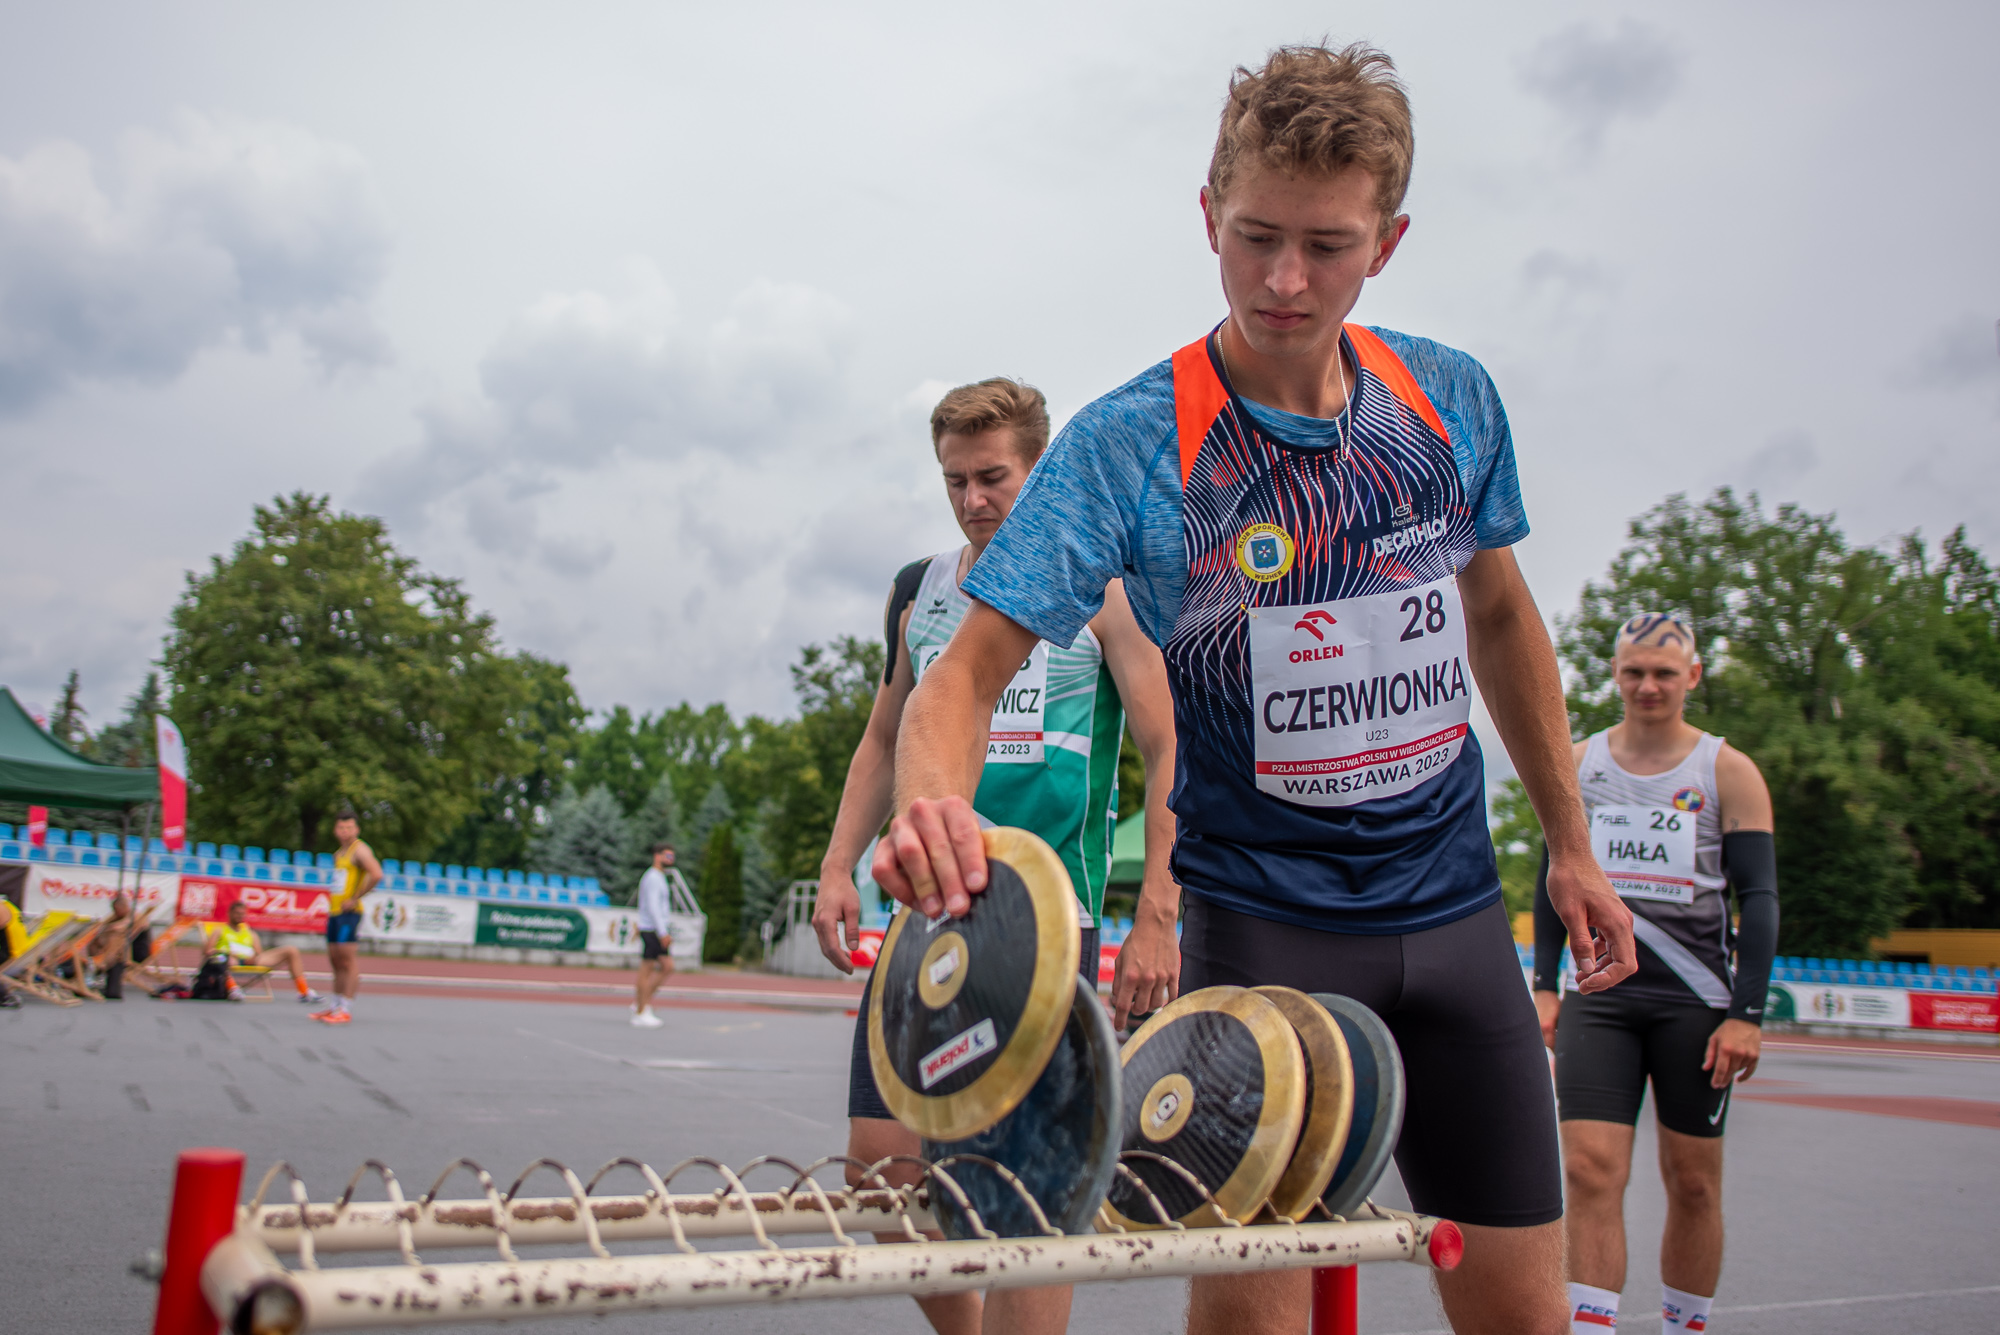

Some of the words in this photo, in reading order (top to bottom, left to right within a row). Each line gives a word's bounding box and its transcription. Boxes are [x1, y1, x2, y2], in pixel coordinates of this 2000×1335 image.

[1238, 531, 1251, 549] KLUB
[1253, 524, 1290, 541] SPORTOWY
[1254, 570, 1283, 580] WEJHER
[1399, 589, 1446, 642] 28
[1288, 644, 1344, 664] ORLEN
[994, 688, 1042, 714] WICZ
[1263, 656, 1468, 734] CZERWIONKA
[1365, 728, 1389, 742] U23
[1000, 743, 1031, 755] 2023
[1271, 764, 1295, 774] PZLA
[1296, 756, 1360, 773] MISTRZOSTWA
[1359, 751, 1389, 764] POLSKI
[1389, 748, 1398, 759] W
[1398, 735, 1444, 758] WIELOBOJACH
[1443, 728, 1458, 742] 2023
[1283, 763, 1411, 795] WARSZAWA
[1414, 747, 1450, 776] 2023
[1650, 810, 1682, 832] 26
[1608, 839, 1670, 863] HAŁA
[1611, 880, 1652, 892] RSZAWA
[1655, 883, 1682, 895] 2023
[240, 886, 331, 917] PZLA
